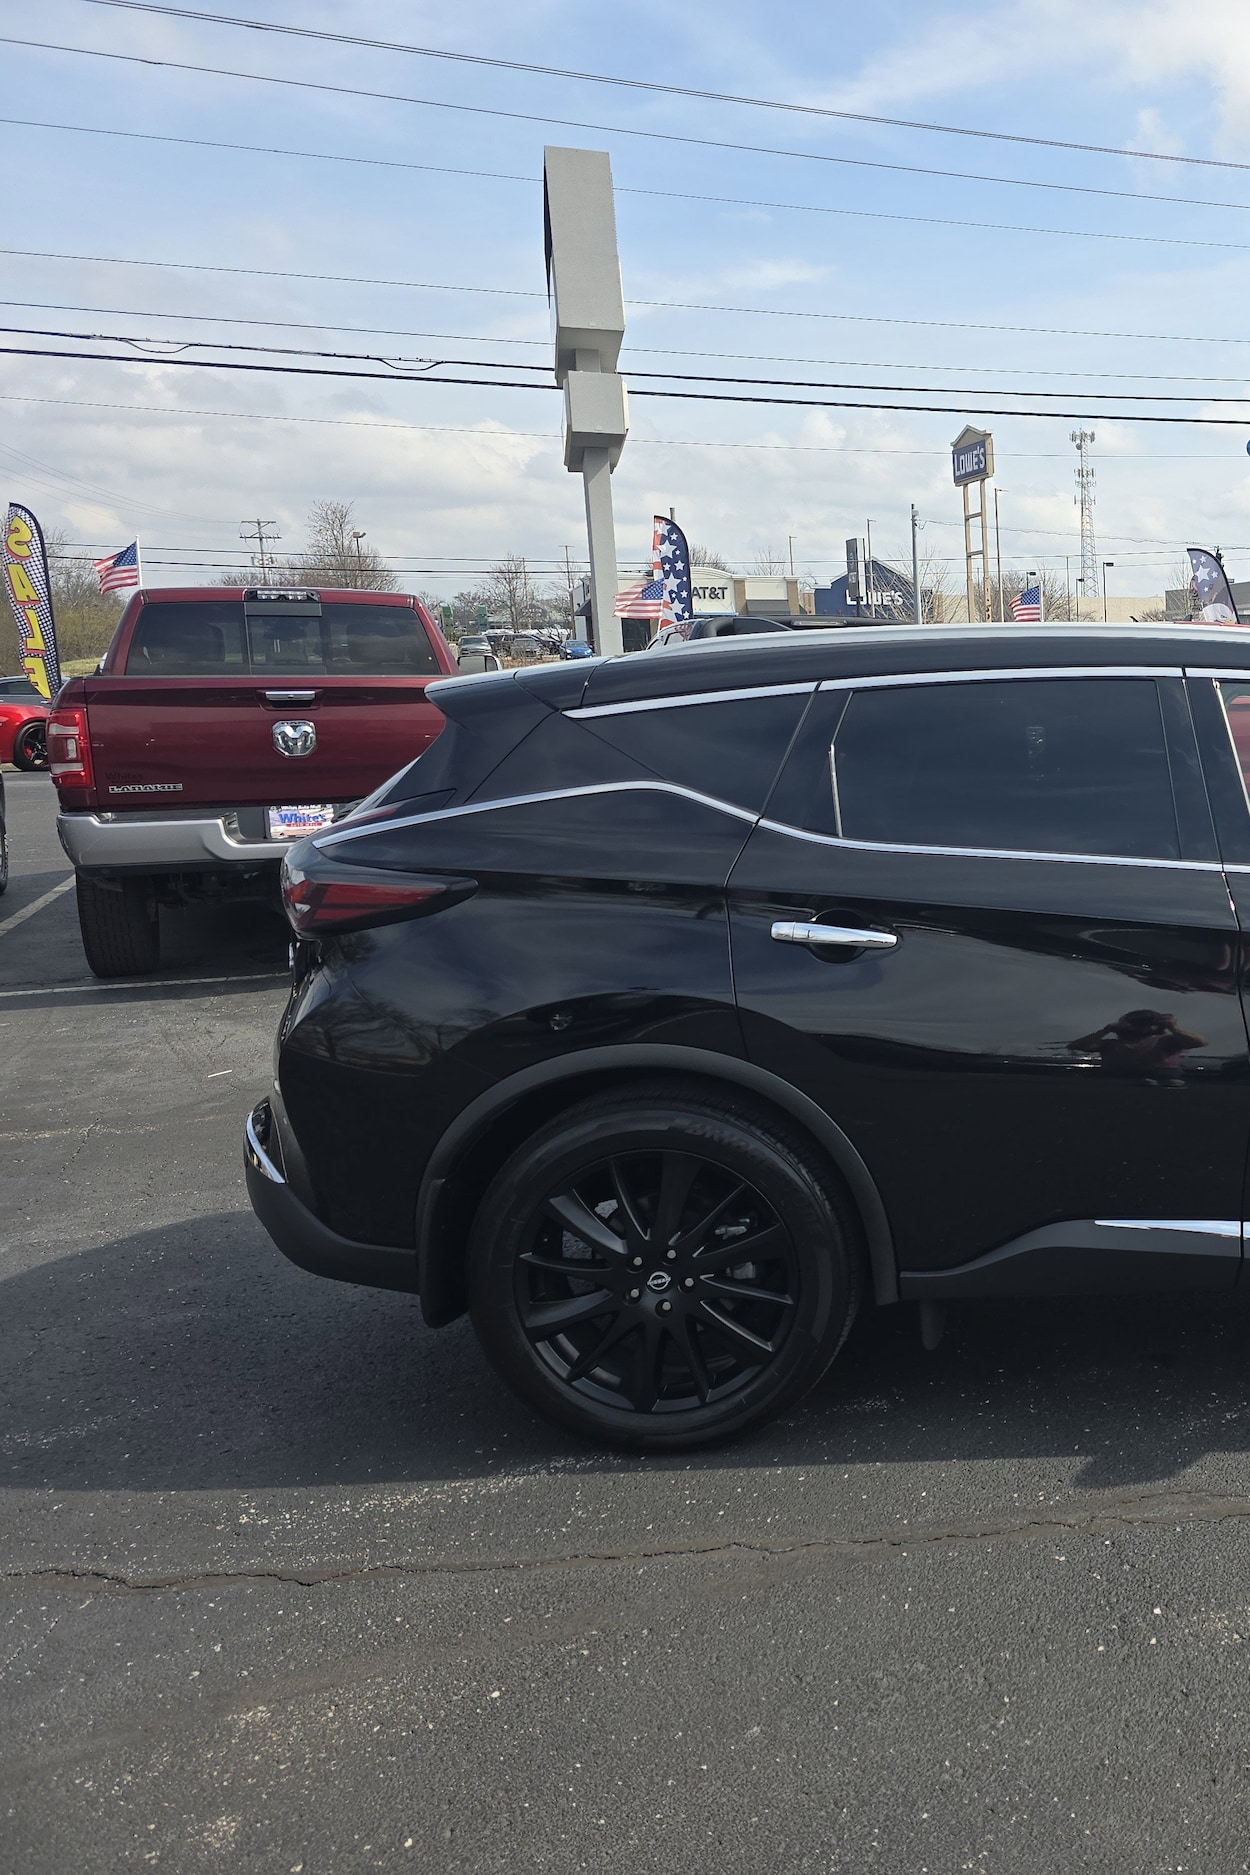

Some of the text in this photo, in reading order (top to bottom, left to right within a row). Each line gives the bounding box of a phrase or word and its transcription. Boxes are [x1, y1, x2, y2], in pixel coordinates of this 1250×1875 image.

[954, 446, 985, 476] LOWE'S
[692, 587, 728, 600] AT&T
[279, 813, 327, 824] White's
